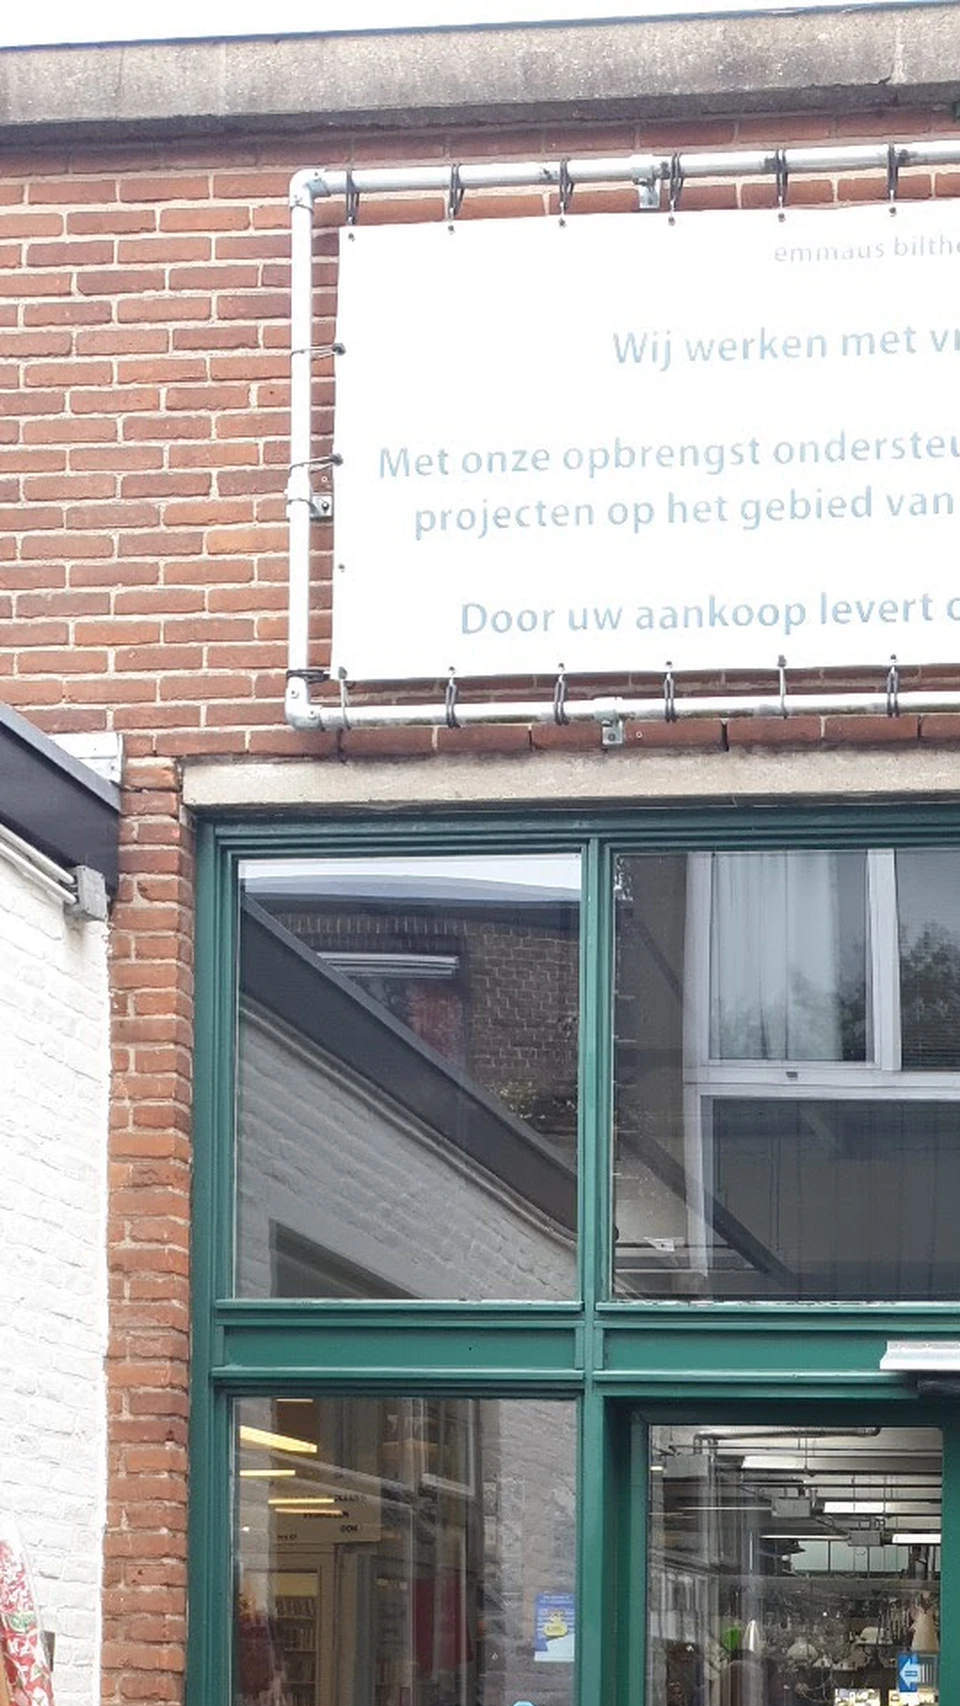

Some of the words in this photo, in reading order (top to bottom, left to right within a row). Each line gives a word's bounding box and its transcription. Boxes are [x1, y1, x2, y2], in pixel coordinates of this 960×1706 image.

[774, 241, 885, 263] emmaus
[612, 329, 673, 372] Wij
[685, 327, 828, 362] werken
[841, 326, 917, 360] met
[378, 445, 450, 478] Met
[461, 446, 552, 475] onze
[562, 437, 762, 479] opbrengst
[414, 498, 594, 541] projecten
[606, 501, 655, 534] op
[667, 491, 728, 524] het
[740, 485, 873, 530] gebied
[885, 486, 954, 518] van
[461, 602, 555, 636] Door
[567, 603, 623, 631] uw
[635, 595, 807, 635] aankoop
[819, 592, 934, 626] levert
